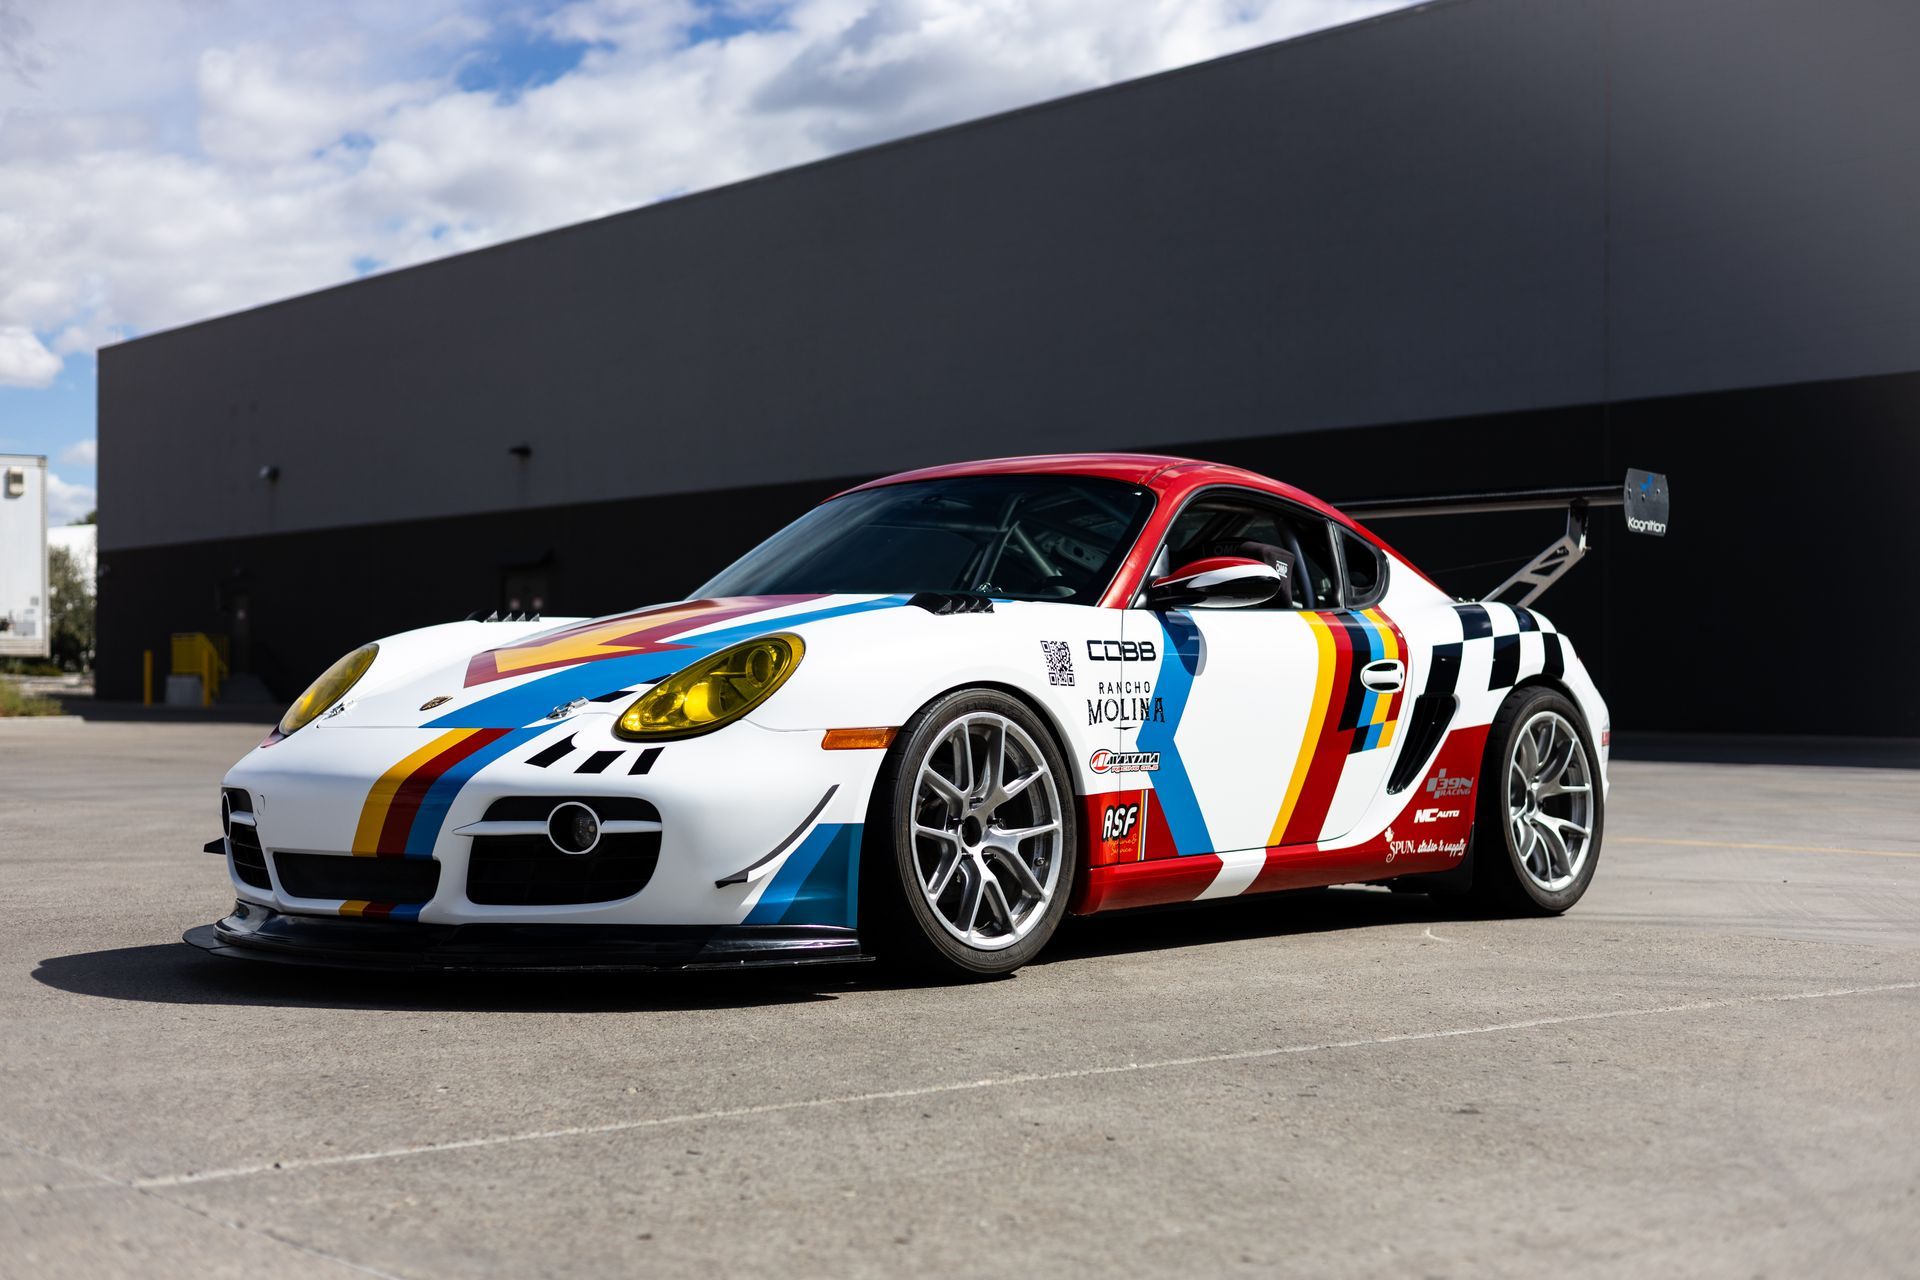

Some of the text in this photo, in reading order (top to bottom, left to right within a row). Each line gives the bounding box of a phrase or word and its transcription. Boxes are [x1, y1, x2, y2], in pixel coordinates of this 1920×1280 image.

[1628, 516, 1665, 533] Kognition
[1086, 639, 1156, 661] COBB
[1098, 680, 1151, 695] RANCHO
[1087, 697, 1165, 727] MOLINA
[1106, 754, 1159, 765] MAXIMA
[1439, 789, 1471, 797] RACING
[1437, 809, 1460, 818] AUTO
[1103, 806, 1138, 839] ASF
